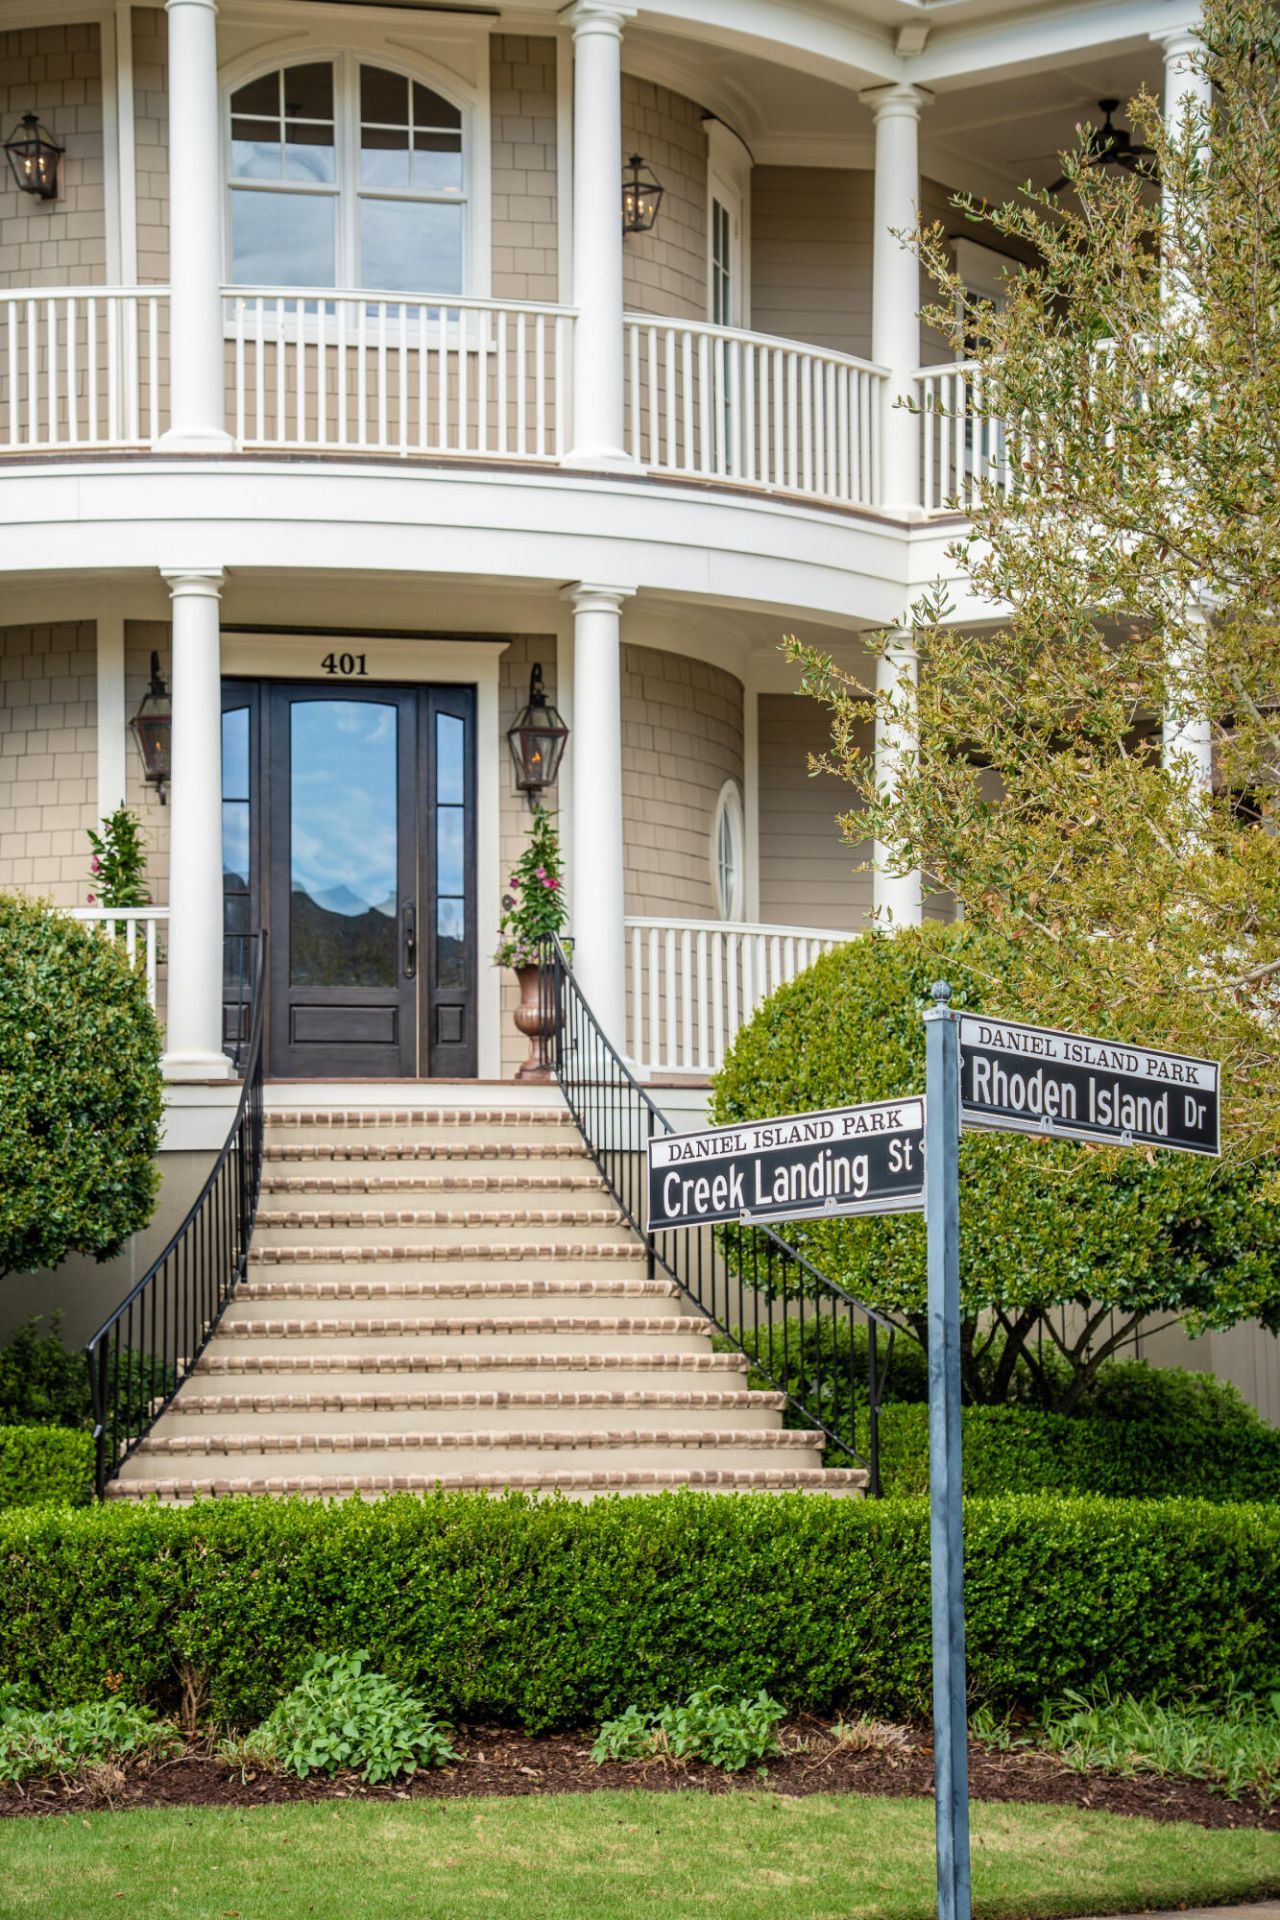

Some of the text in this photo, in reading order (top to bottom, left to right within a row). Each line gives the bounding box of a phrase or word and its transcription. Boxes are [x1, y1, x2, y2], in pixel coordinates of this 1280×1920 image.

[321, 652, 369, 675] 401
[978, 1026, 1200, 1085] DANIEL ISLAND PARK
[972, 1056, 1206, 1136] Rhoden Island Dr
[668, 1109, 903, 1162] DANIEL ISLAND PARK
[663, 1138, 913, 1218] Creek Landing St
